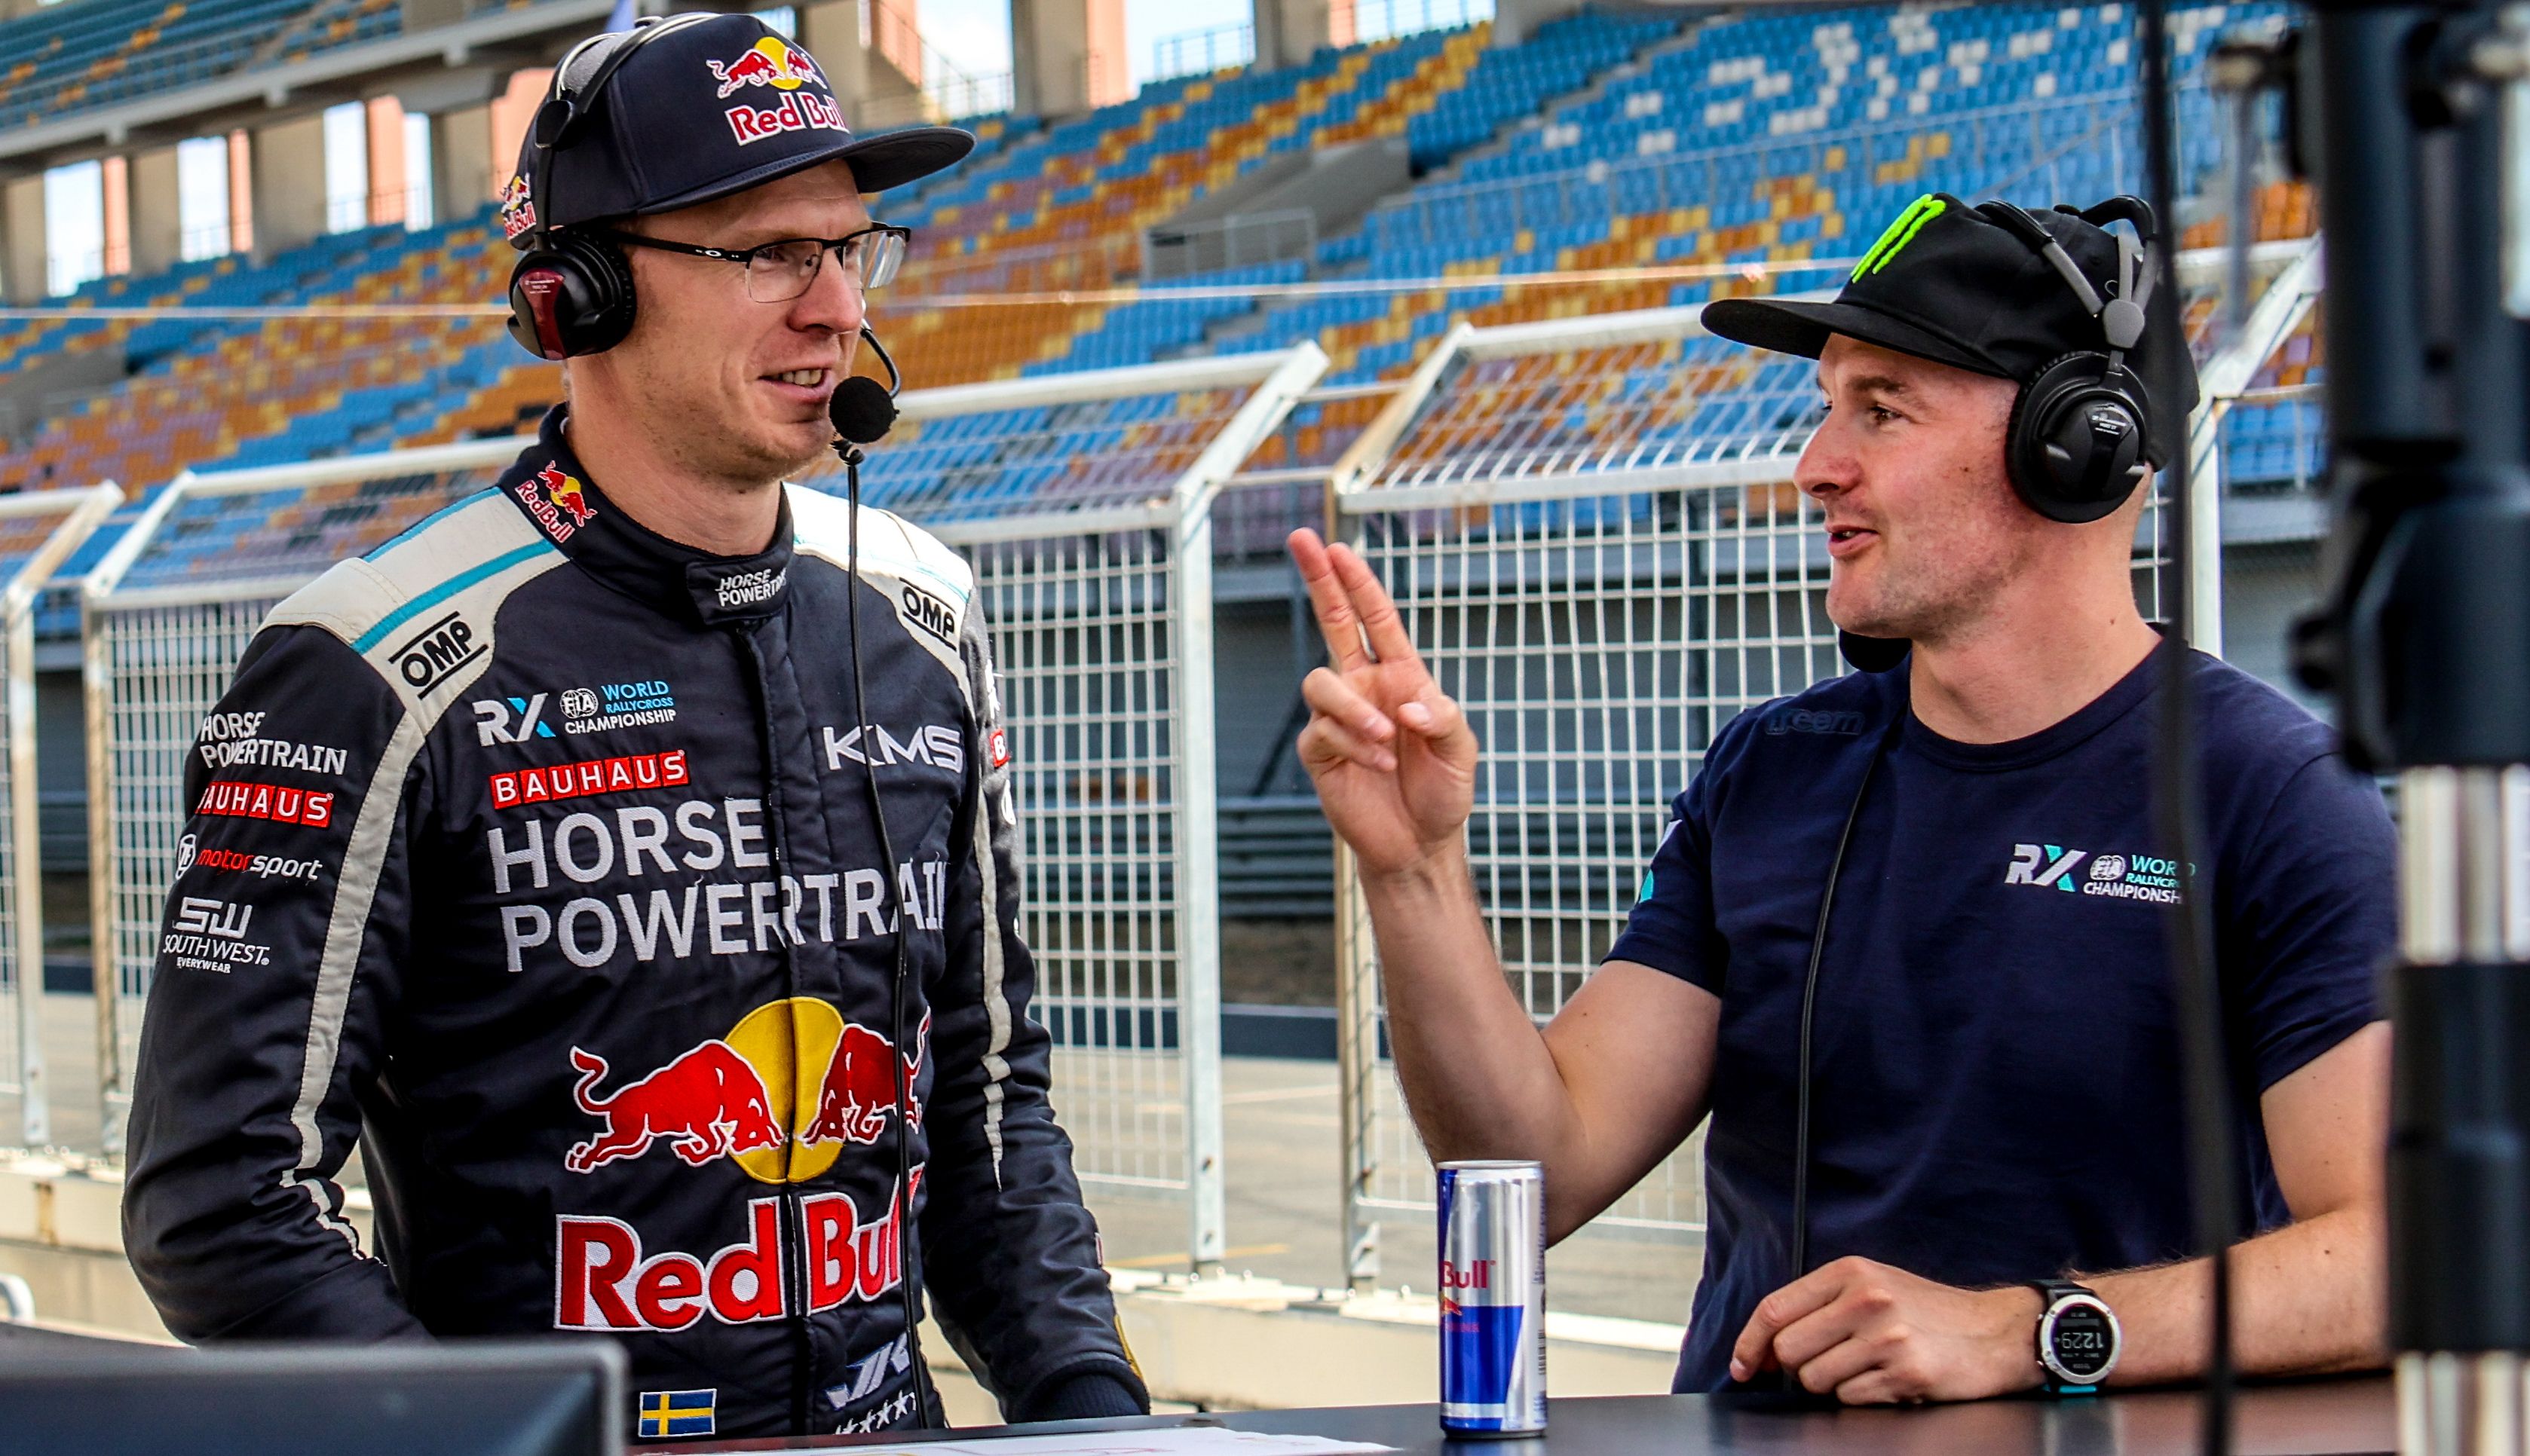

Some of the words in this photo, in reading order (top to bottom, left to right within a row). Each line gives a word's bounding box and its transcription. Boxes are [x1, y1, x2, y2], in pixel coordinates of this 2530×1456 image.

[724, 91, 807, 145] Red
[515, 480, 552, 515] Red
[537, 506, 575, 543] Bull
[717, 568, 772, 591] HORSE
[903, 586, 954, 638] OMP
[401, 621, 472, 687] OMP
[562, 691, 596, 716] FIA
[601, 681, 669, 702] WORLD
[605, 696, 675, 714] RALLYCROSS
[201, 711, 265, 742] HORSE
[471, 692, 556, 747] RX
[565, 708, 677, 735] CHAMPIONSHIP
[822, 723, 963, 774] KMS
[494, 754, 685, 803] BAUHAUS
[197, 785, 329, 821] AUHAUS
[486, 797, 772, 894] HORSE
[196, 849, 323, 880] motorsport
[2004, 843, 2088, 893] RX
[2130, 854, 2195, 877] WOR
[2083, 881, 2183, 904] CHAMPIONSH
[2124, 872, 2180, 889] RALLYCR
[176, 956, 231, 974] EVERYWEAR
[553, 1196, 789, 1332] Red
[2060, 1332, 2104, 1349] 1229
